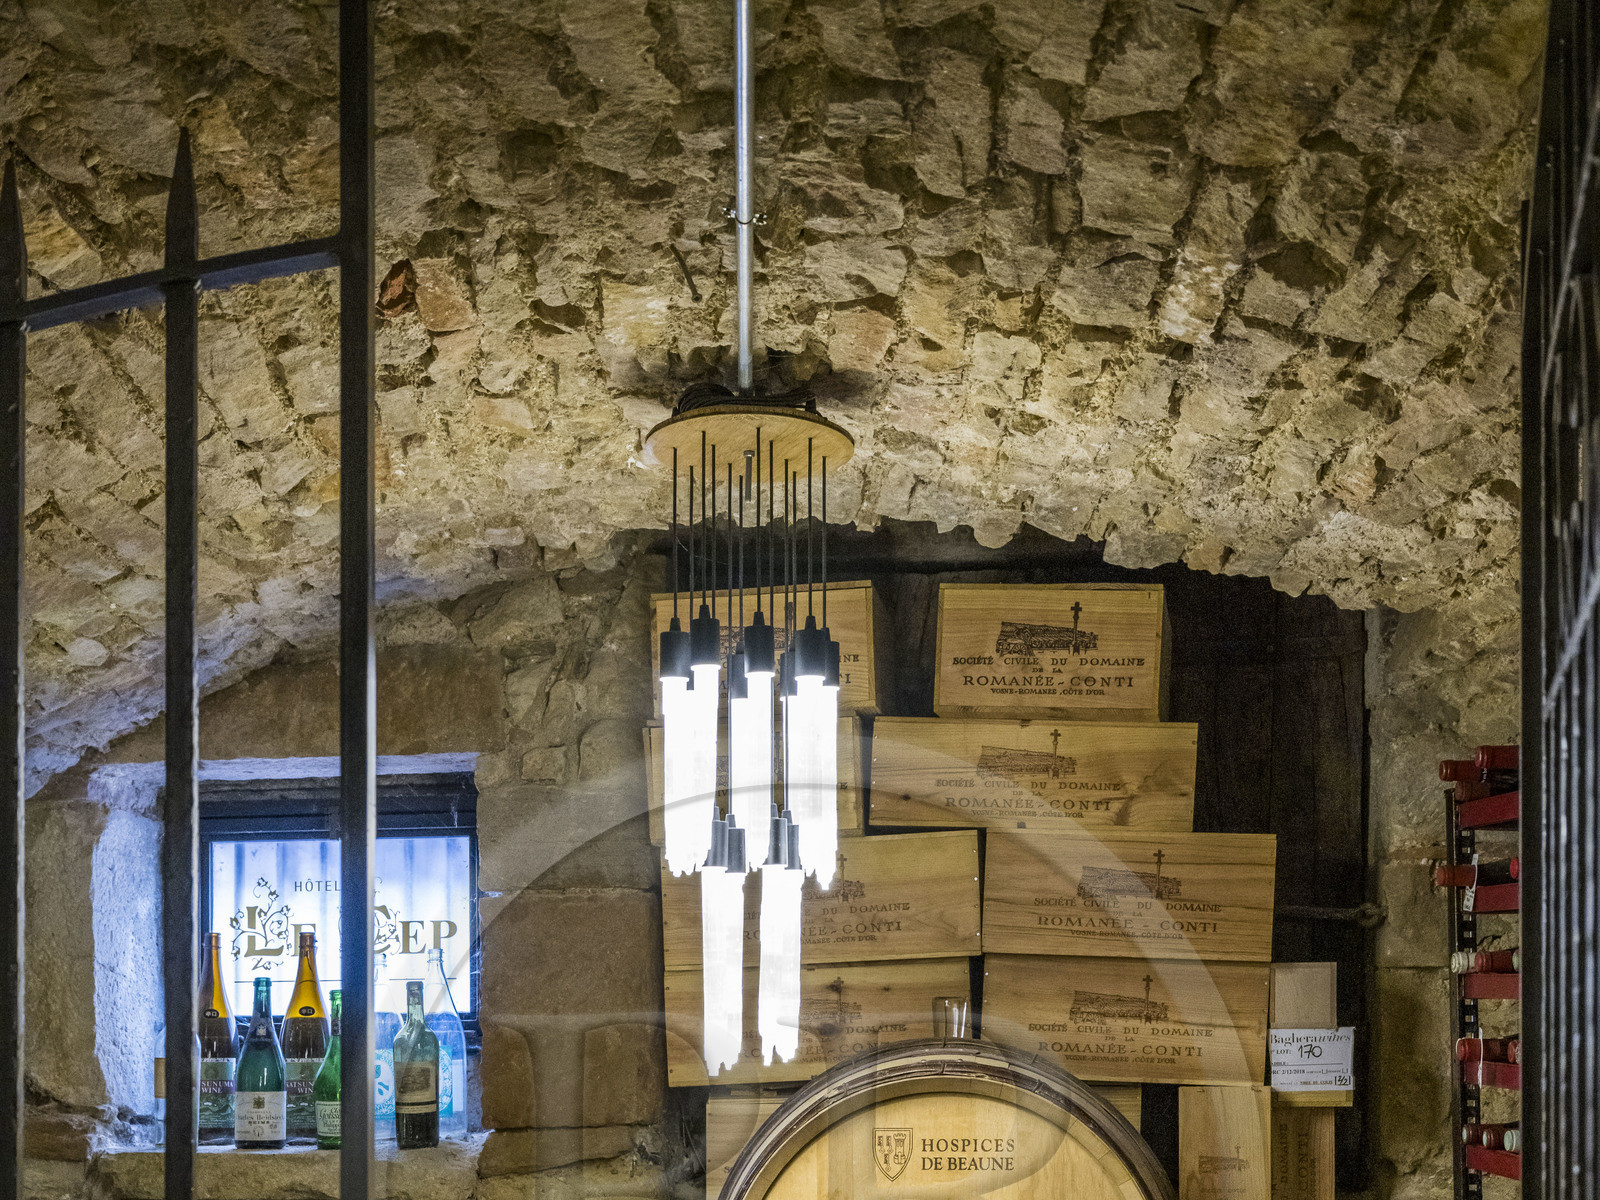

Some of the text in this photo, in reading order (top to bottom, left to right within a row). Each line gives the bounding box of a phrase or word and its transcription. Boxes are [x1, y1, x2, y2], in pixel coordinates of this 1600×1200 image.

[952, 655, 994, 666] SOCIÉTÉ
[1004, 657, 1039, 666] CIVILE
[1079, 657, 1145, 667] DOMAINE
[936, 777, 1121, 791] SOCIÉTÉ CIVILE DU DOMAINE
[849, 902, 911, 914] DOMAINE
[1034, 896, 1222, 913] SOCIÉTÉ CIVILE DU DOMAINE
[1028, 1022, 1213, 1037] SOCIÉTÉ CIVILE DU DOMAINE
[1298, 1044, 1323, 1059] 170
[922, 1138, 1015, 1152] HOSPICES
[921, 1157, 1015, 1171] DE BEAUNE
